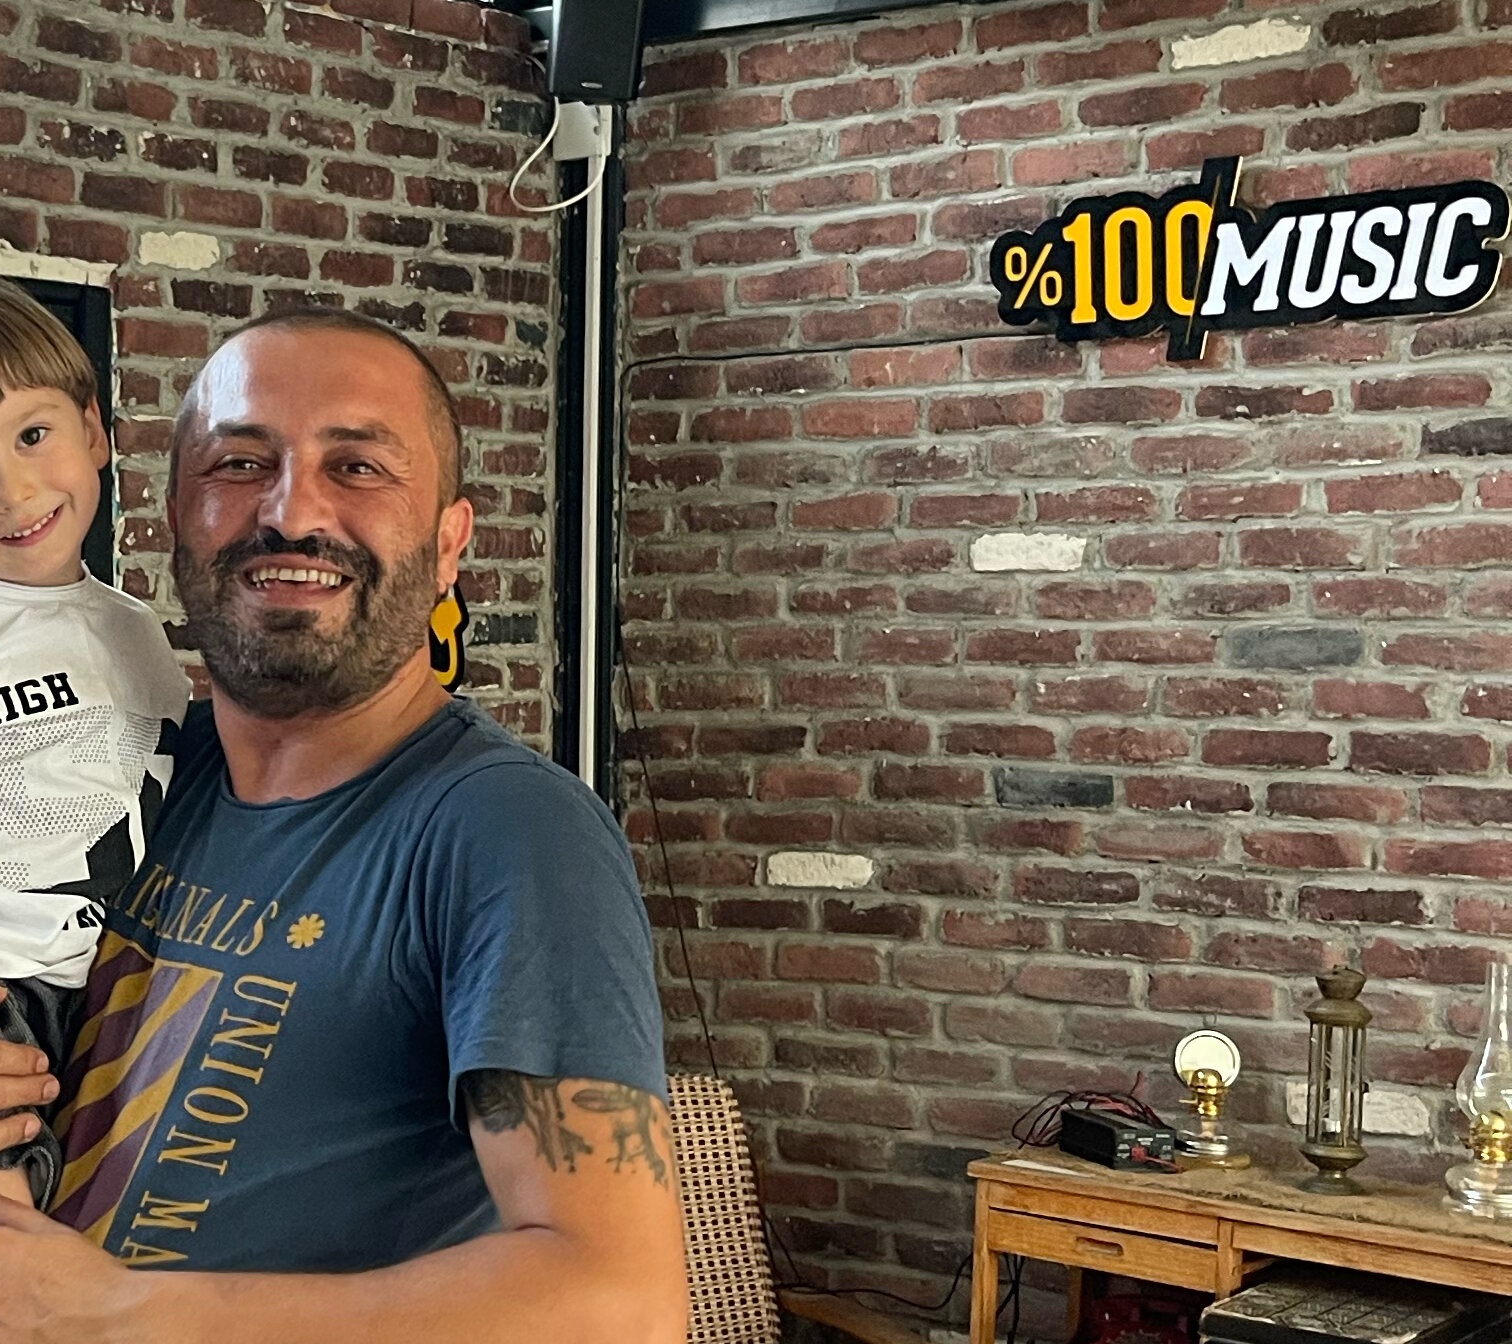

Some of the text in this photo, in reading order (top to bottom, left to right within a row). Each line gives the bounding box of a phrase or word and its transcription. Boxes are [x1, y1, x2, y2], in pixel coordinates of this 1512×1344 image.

[1004, 196, 1491, 324] %100 MUSIC
[157, 974, 297, 1176] UNION
